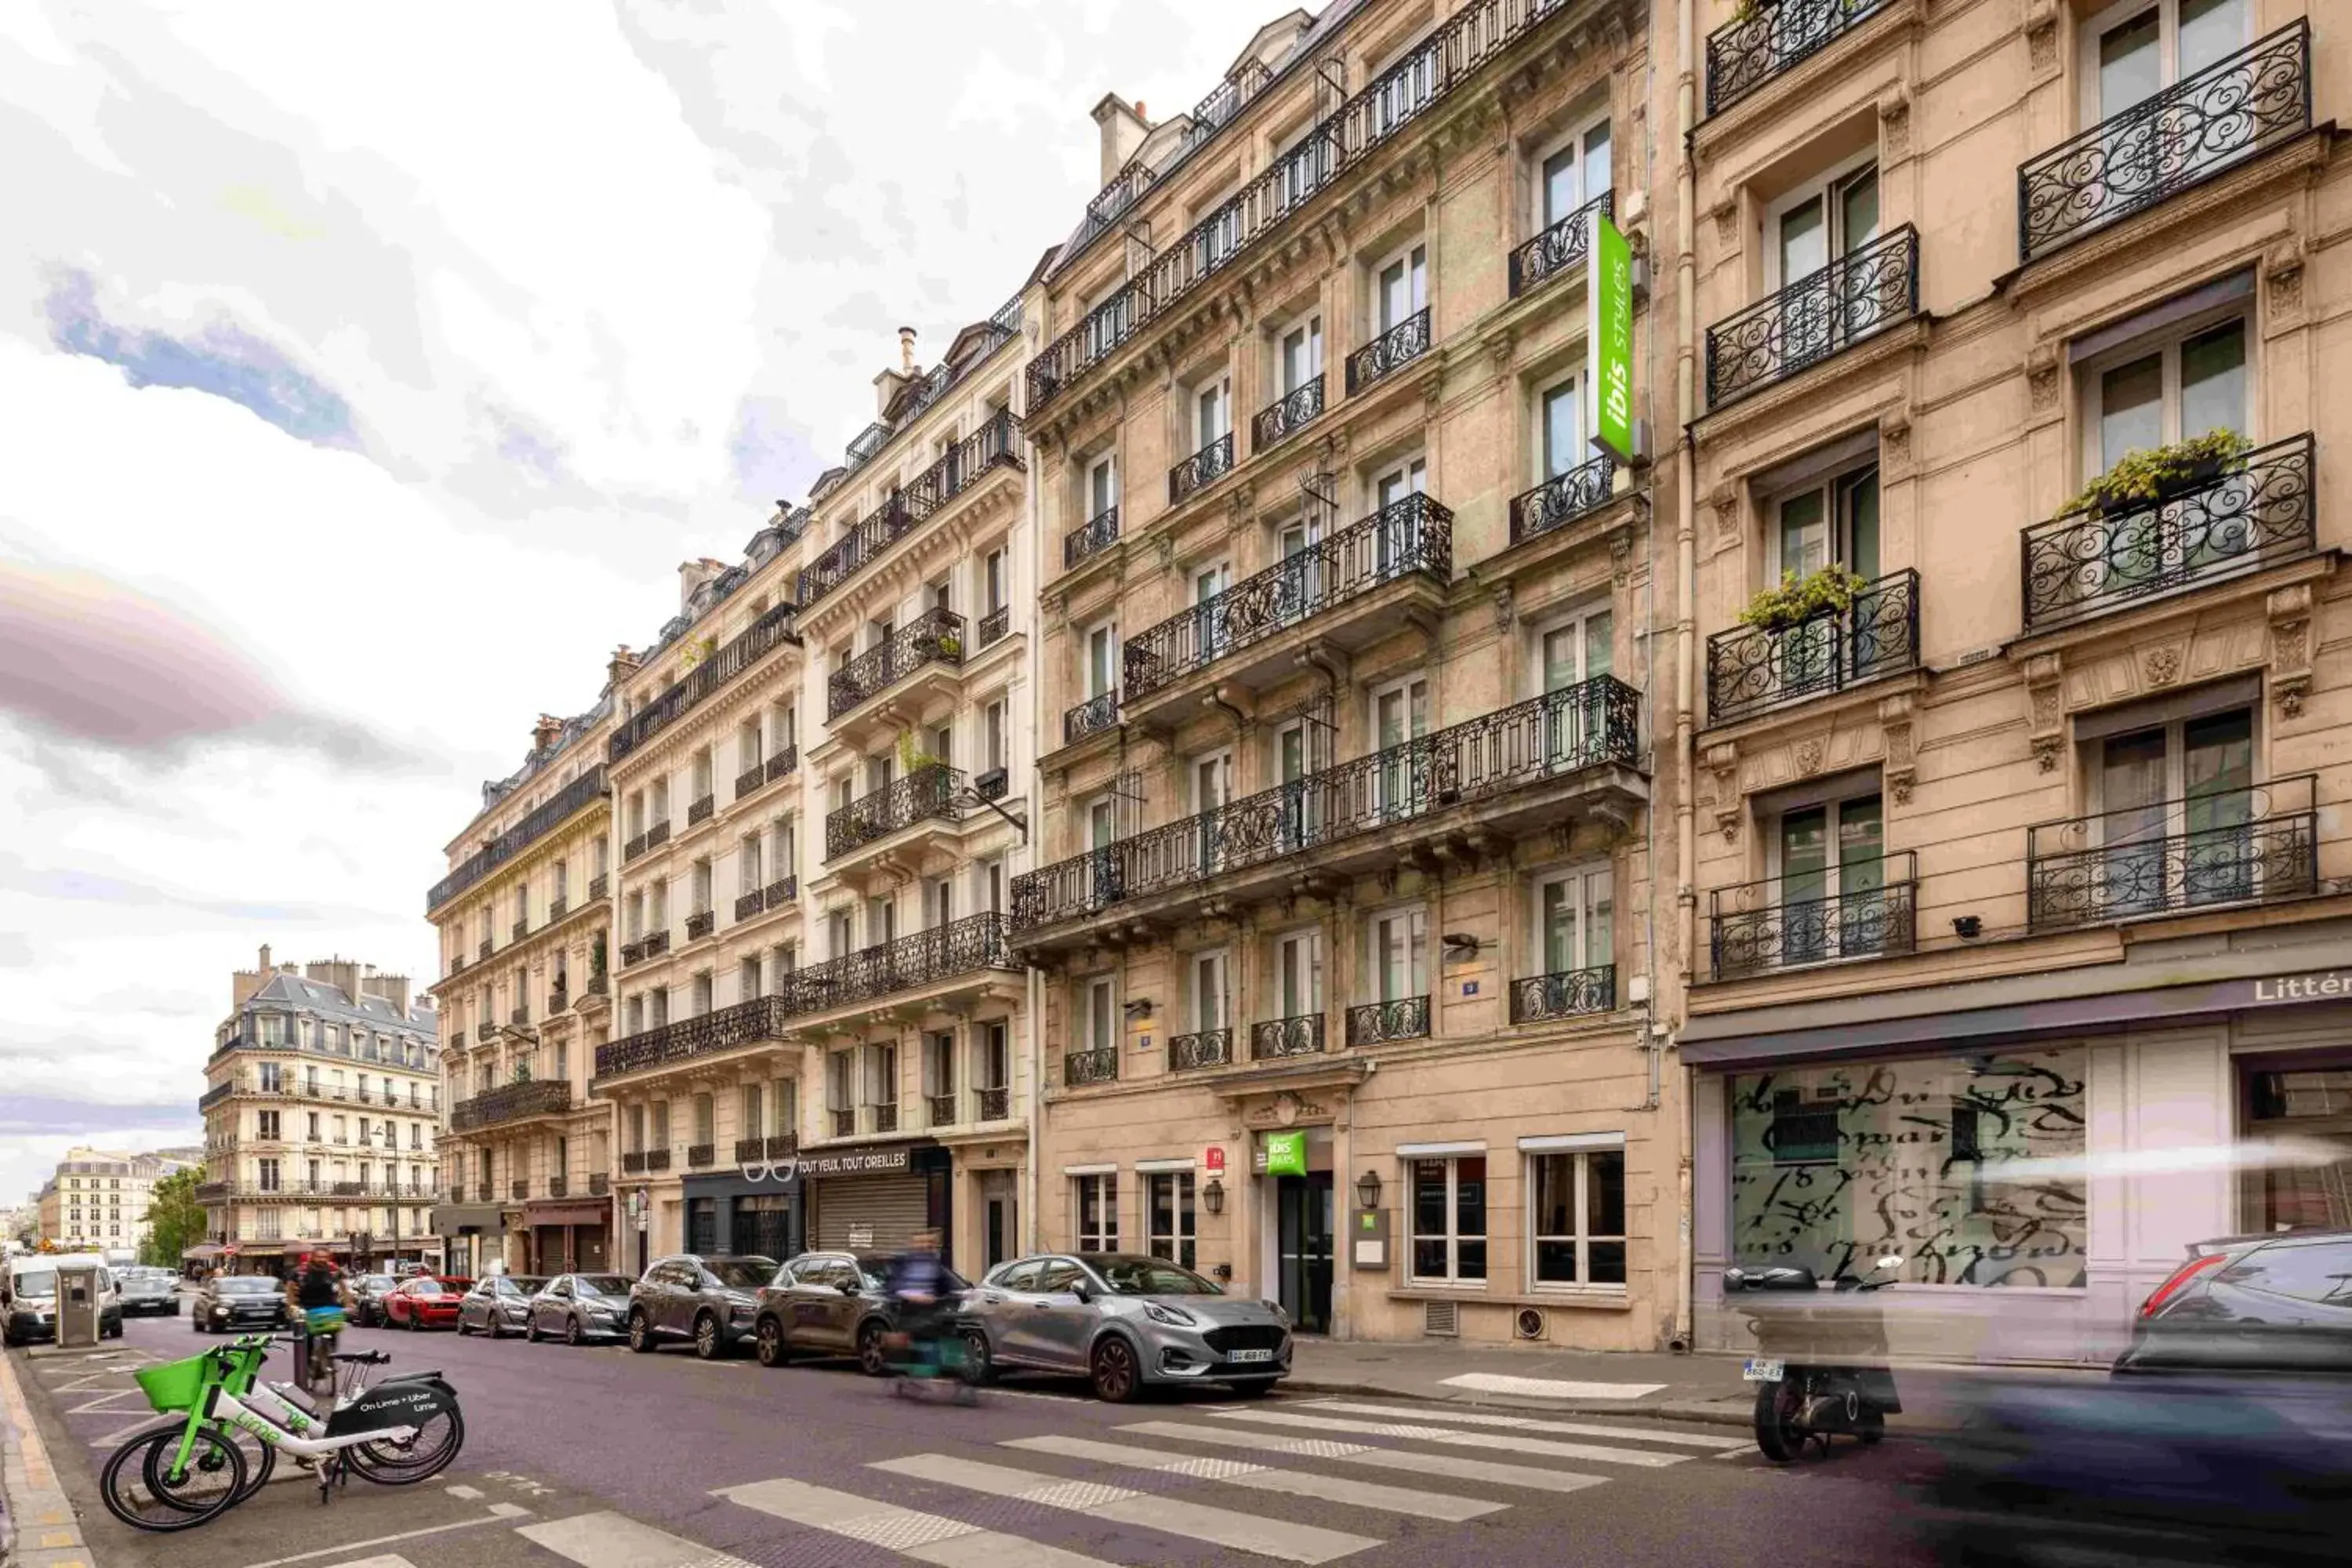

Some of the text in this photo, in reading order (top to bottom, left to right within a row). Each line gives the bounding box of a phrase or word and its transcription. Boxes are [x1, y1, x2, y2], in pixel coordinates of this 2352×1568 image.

[1606, 357, 1627, 429] ibis
[798, 1160, 817, 1174] TOUT
[842, 1156, 863, 1171] TOUT
[865, 1153, 906, 1169] OREILLES
[361, 1403, 376, 1412] On
[376, 1399, 400, 1409] Lime
[408, 1392, 431, 1403] Uber
[414, 1402, 437, 1412] Lime
[237, 1410, 281, 1441] Lime
